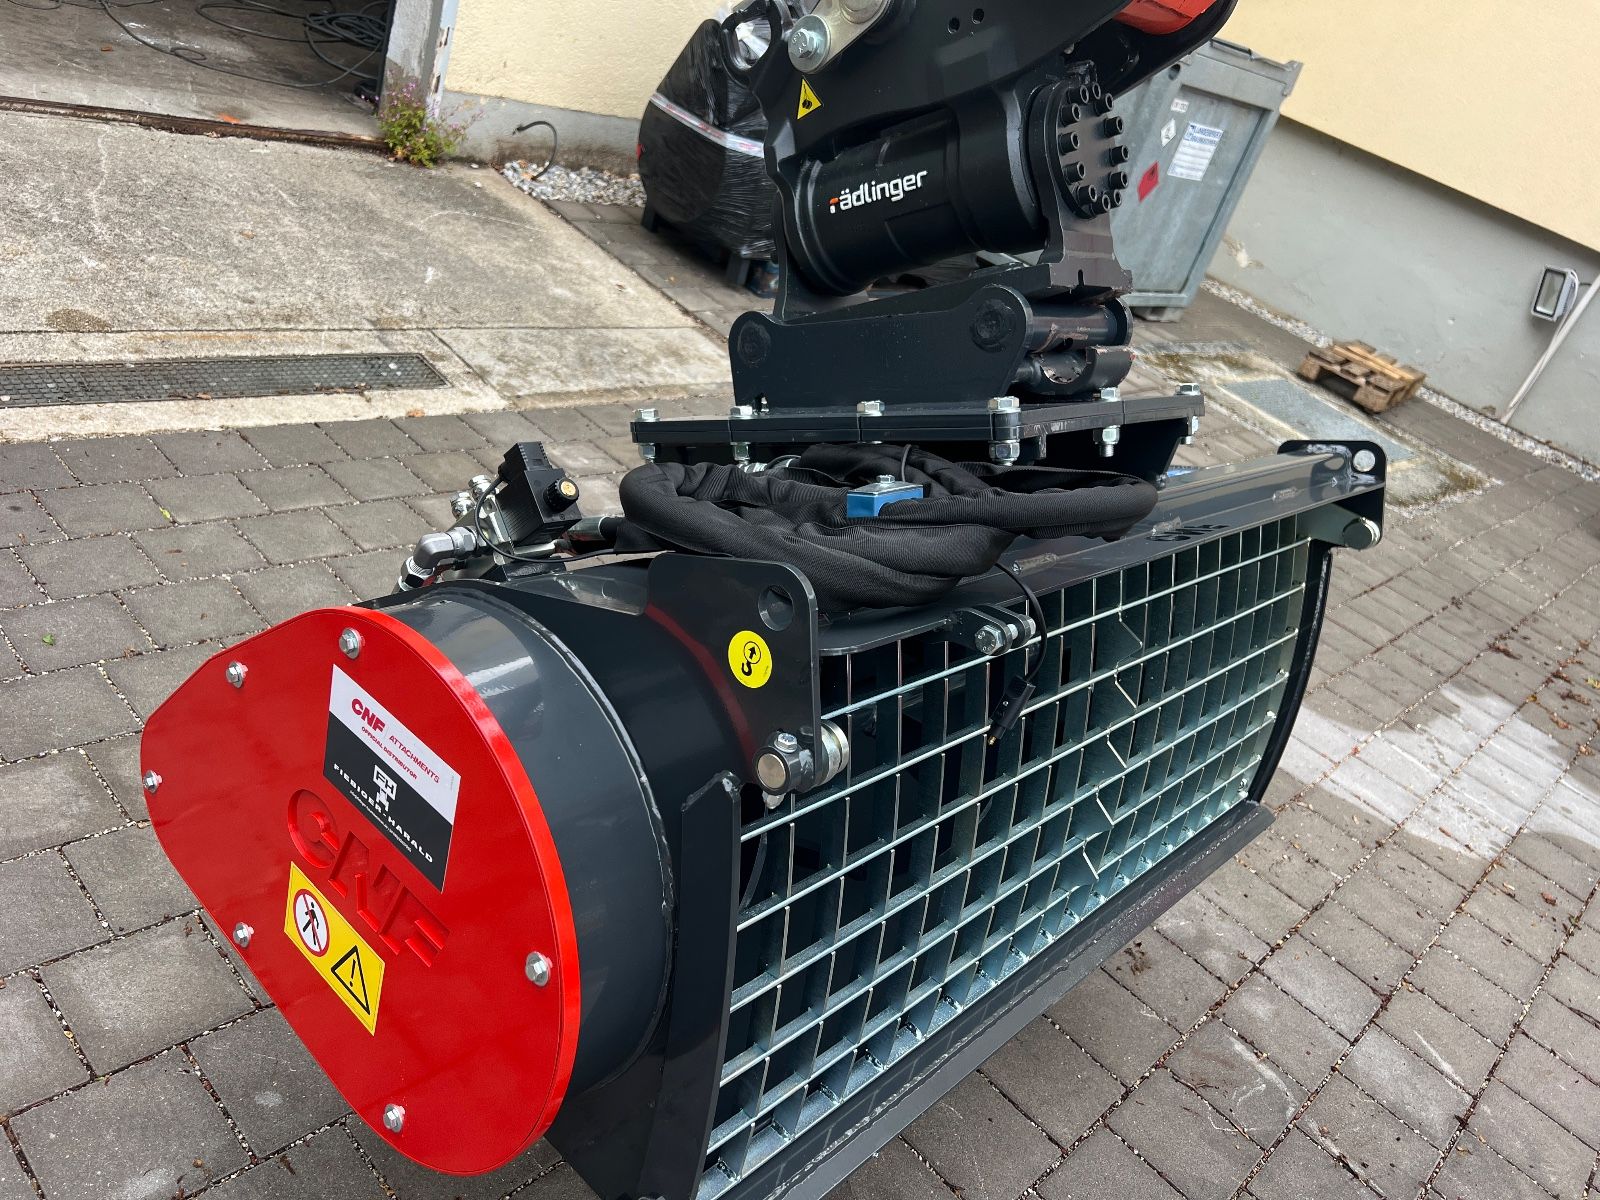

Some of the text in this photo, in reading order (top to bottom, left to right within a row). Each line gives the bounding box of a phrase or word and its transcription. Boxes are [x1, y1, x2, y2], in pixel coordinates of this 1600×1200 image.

[828, 170, 928, 214] rädlinger
[351, 698, 386, 733] CNF
[389, 735, 440, 783] ATTACHMENTS
[361, 726, 418, 780] OFFICIAL DISTRIBUTOR
[375, 771, 396, 795] FH
[287, 788, 451, 968] CNF
